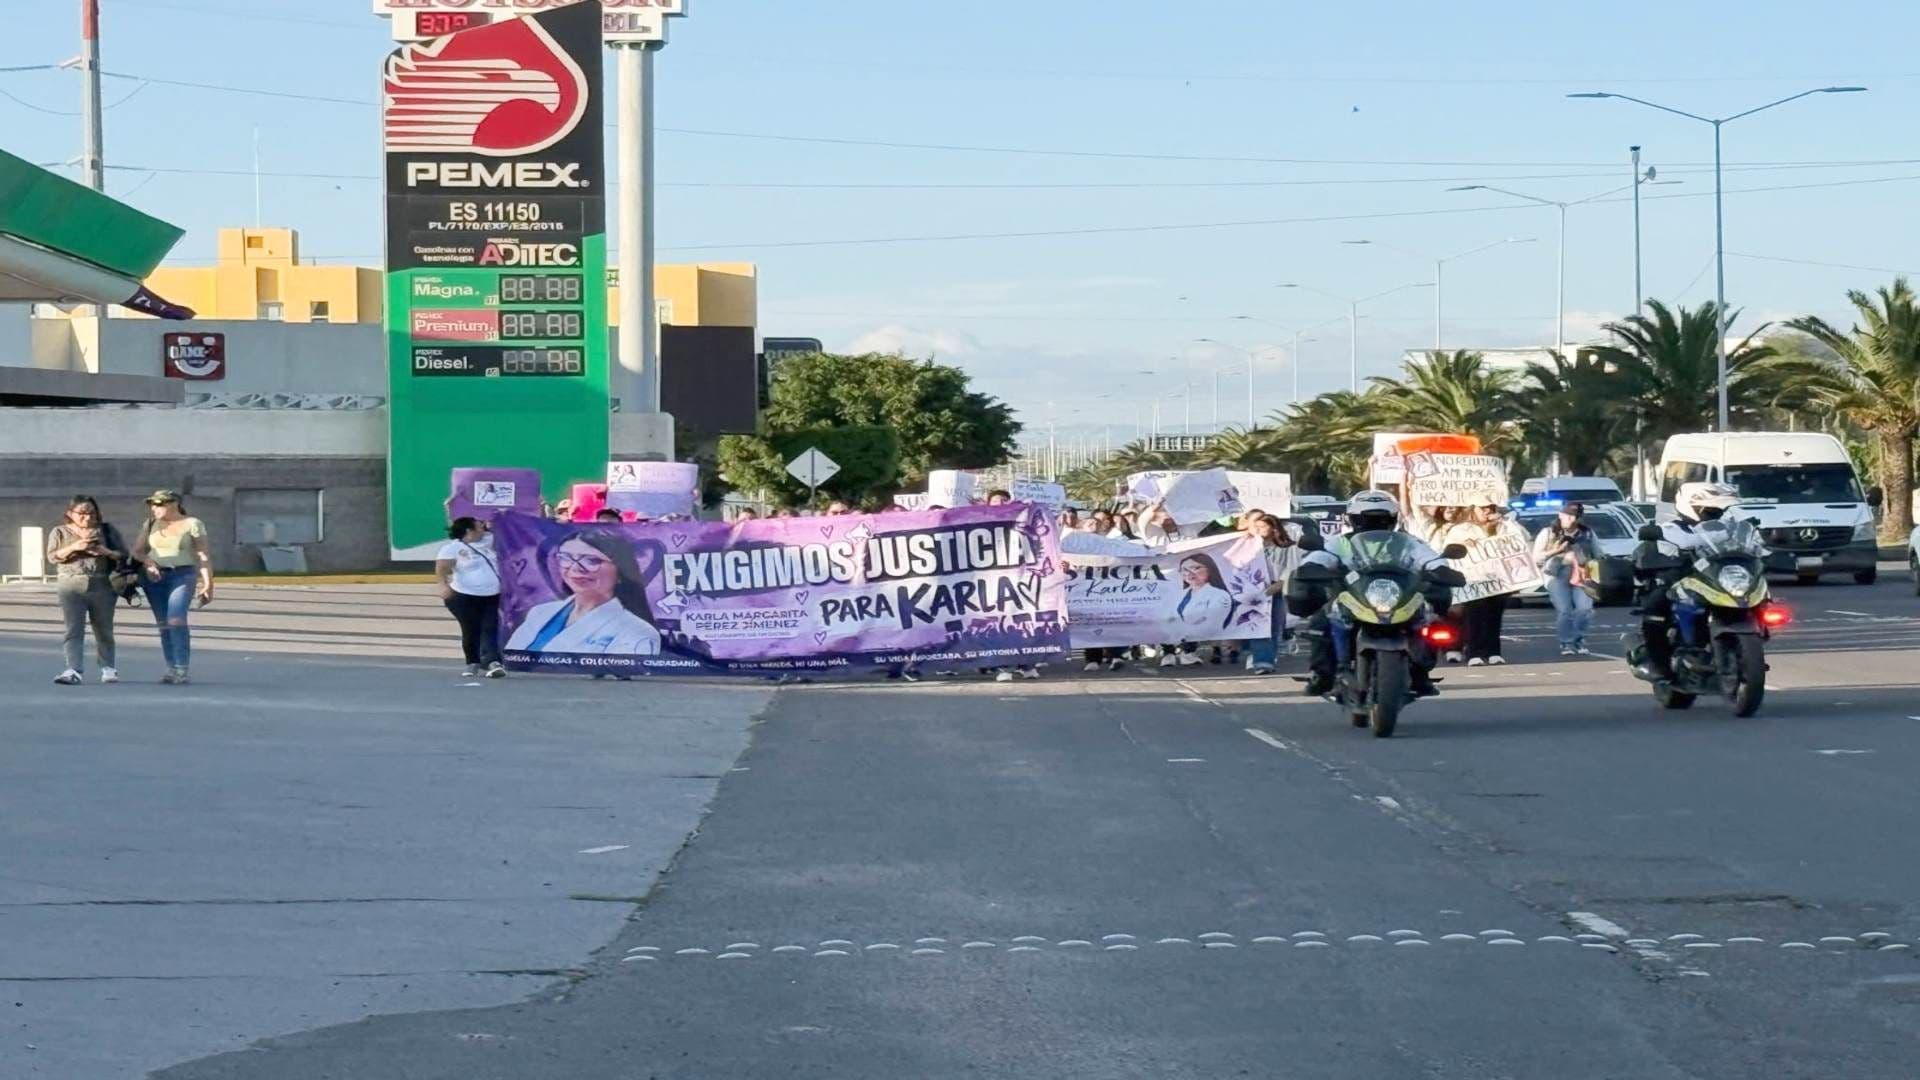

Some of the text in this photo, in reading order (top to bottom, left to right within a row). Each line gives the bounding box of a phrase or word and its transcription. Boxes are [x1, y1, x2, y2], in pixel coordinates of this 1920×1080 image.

[407, 161, 580, 188] PEMEX
[449, 202, 541, 221] ES 11150
[414, 283, 474, 298] Magna
[414, 320, 489, 332] Premium
[415, 355, 468, 369] Diesel
[663, 526, 1036, 593] EXIGIMOS JUSTICIA
[1086, 576, 1143, 598] Karla
[819, 575, 1023, 630] PARA KARLA
[686, 609, 809, 622] KARLA MARGARITA
